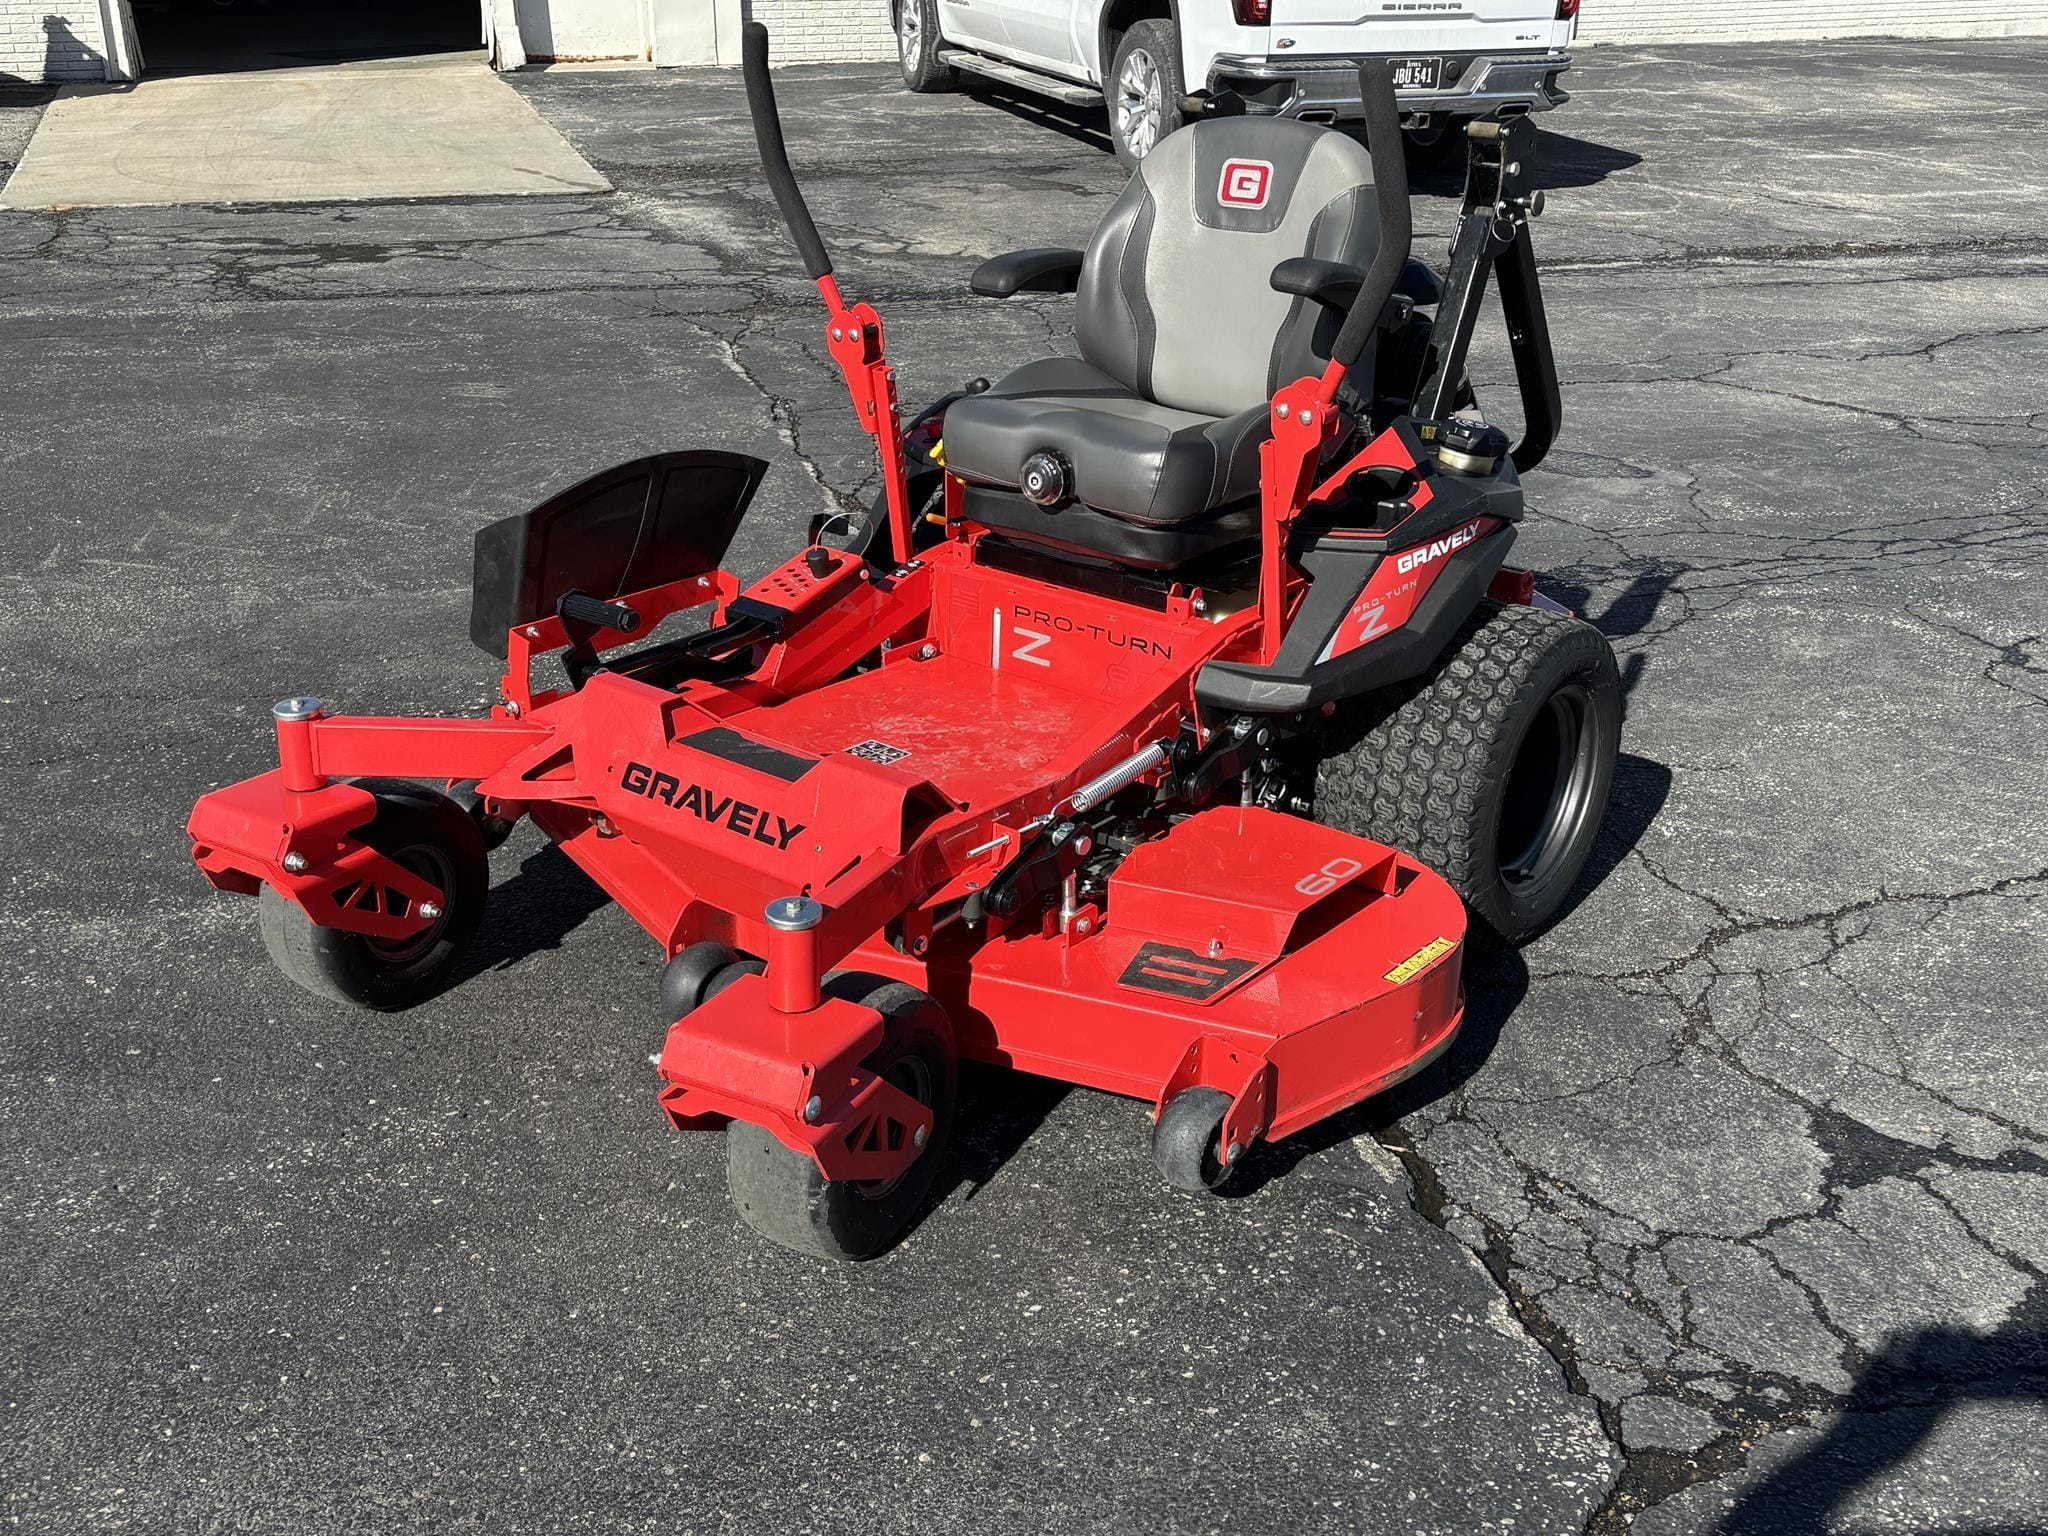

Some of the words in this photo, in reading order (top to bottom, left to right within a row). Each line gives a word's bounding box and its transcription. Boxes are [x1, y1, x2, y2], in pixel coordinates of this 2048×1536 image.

[1382, 3, 1462, 11] SIERRA
[1392, 67, 1412, 84] JBU
[1414, 67, 1432, 84] 541
[1397, 520, 1481, 575] GRAVELY
[1353, 579, 1418, 615] PRO-TURN
[1013, 604, 1172, 660] PRO-TURN
[1357, 605, 1389, 642] Z
[1012, 626, 1051, 667] Z
[620, 761, 807, 851] GRAVELY
[1294, 857, 1362, 896] 60
